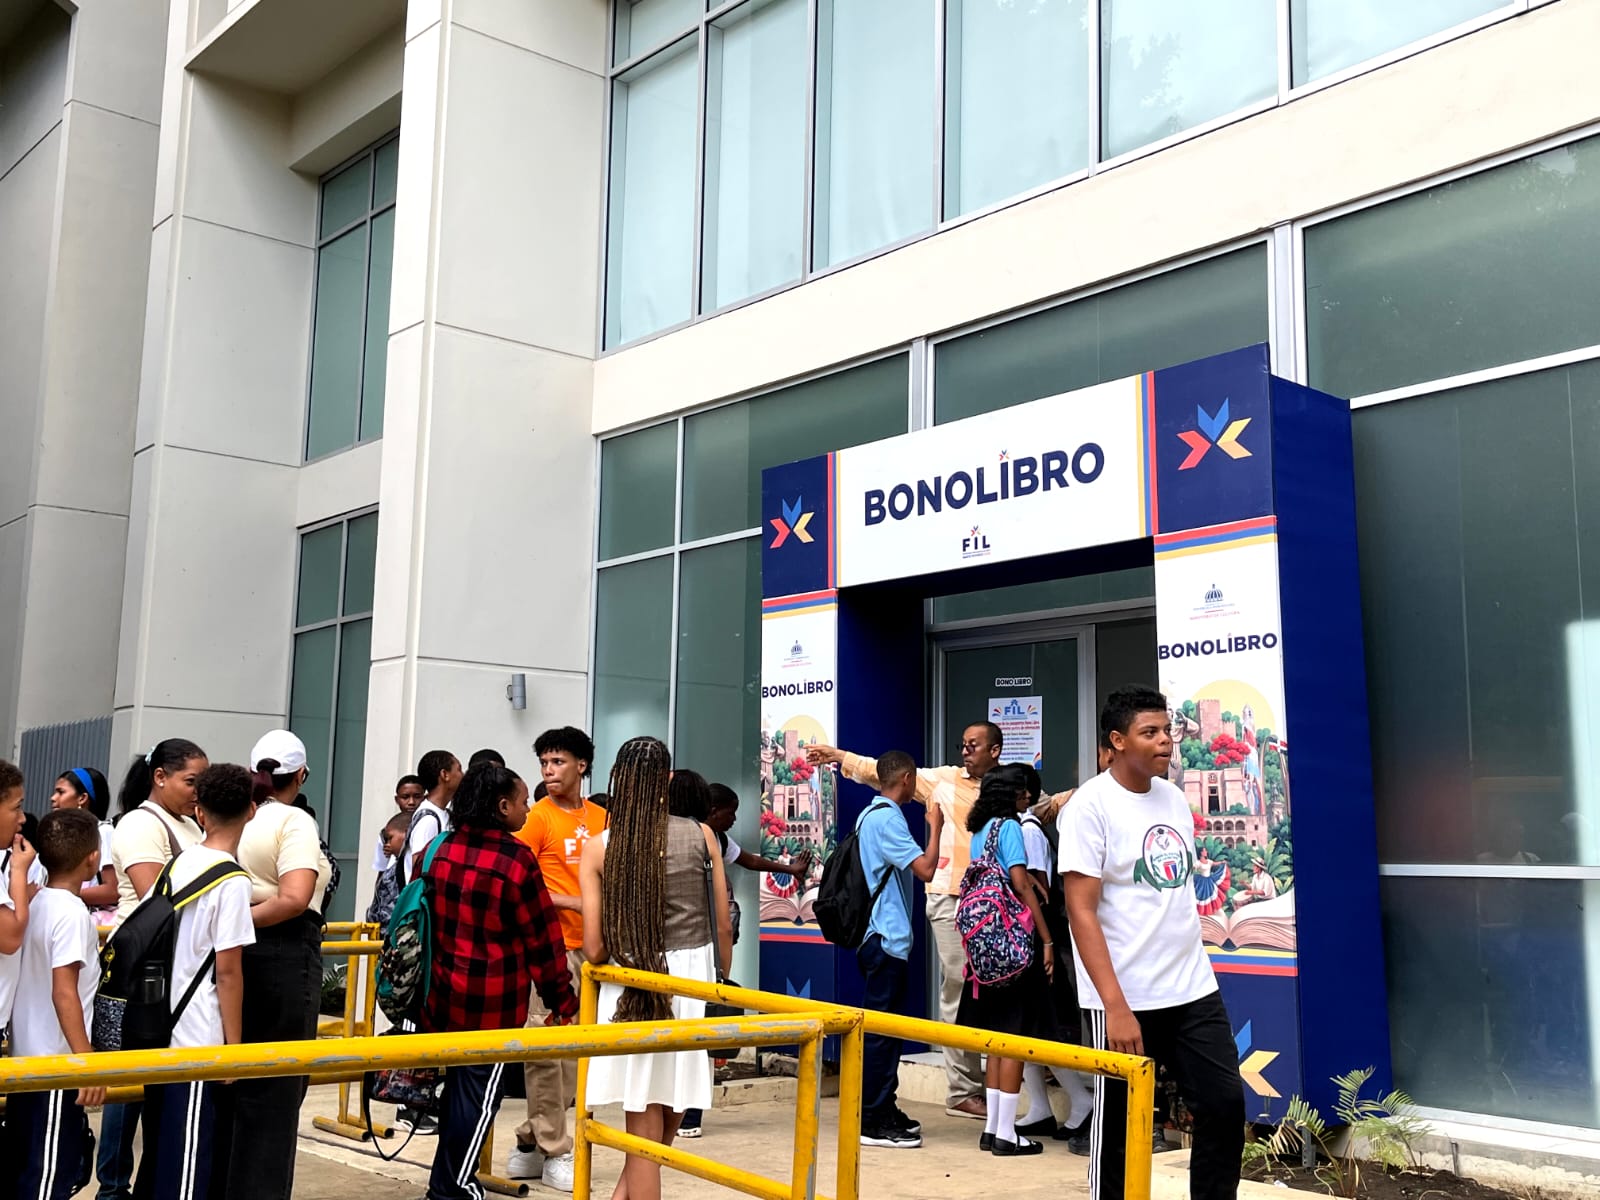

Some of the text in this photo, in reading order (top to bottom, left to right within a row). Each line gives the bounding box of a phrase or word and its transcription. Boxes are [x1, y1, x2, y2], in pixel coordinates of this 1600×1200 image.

[962, 535, 991, 552] FIL
[996, 678, 1032, 686] BONO LIBRO
[1004, 706, 1025, 715] FIL
